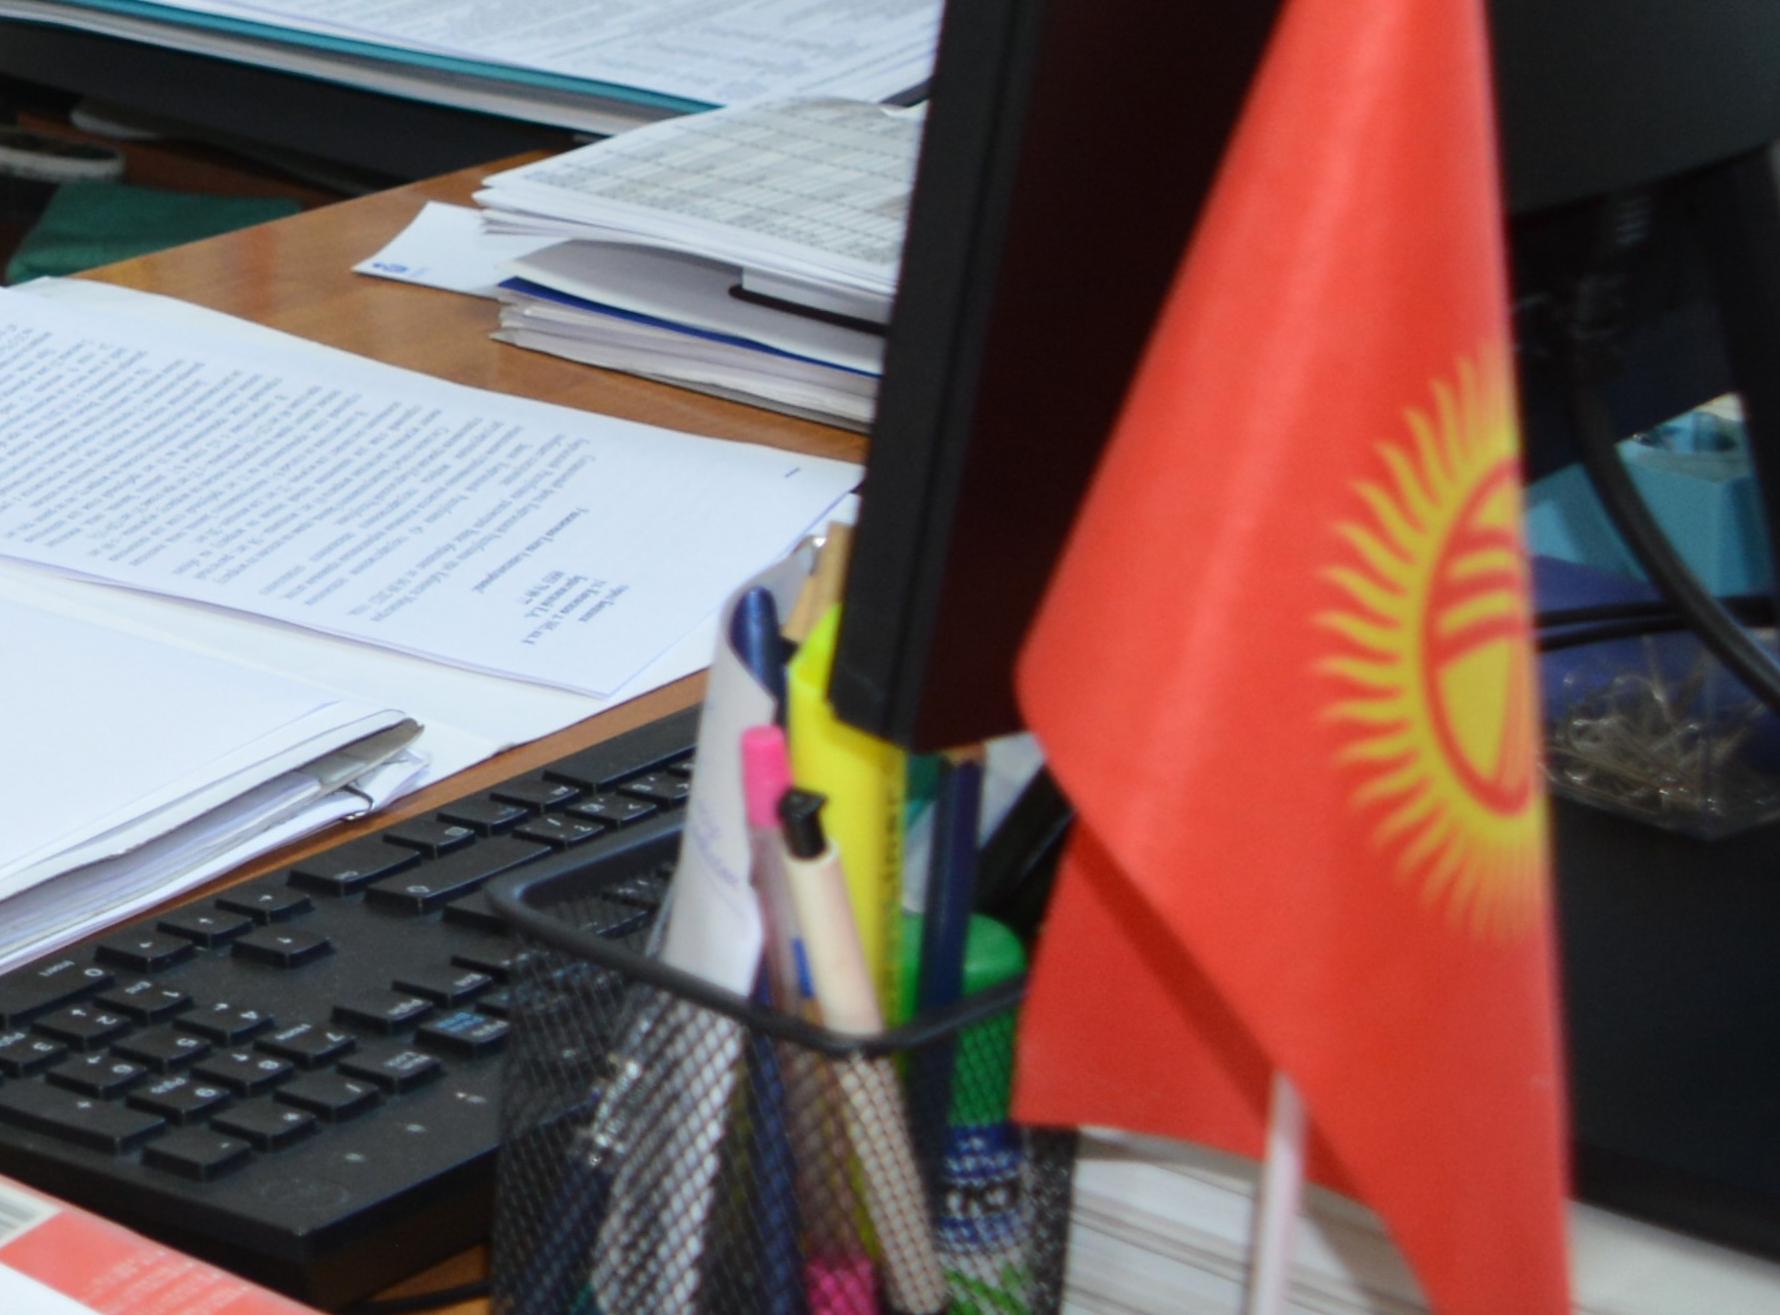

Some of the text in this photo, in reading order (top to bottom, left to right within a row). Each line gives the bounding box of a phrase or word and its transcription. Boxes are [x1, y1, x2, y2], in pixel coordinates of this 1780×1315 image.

[38, 960, 73, 976] Insert
[123, 980, 150, 994] End
[95, 1015, 115, 1024] 2
[31, 1041, 52, 1051] 3
[111, 1010, 257, 1073] 4 5 6
[149, 1023, 310, 1093] Home PgUp
[194, 1032, 343, 1097] 7 8 9
